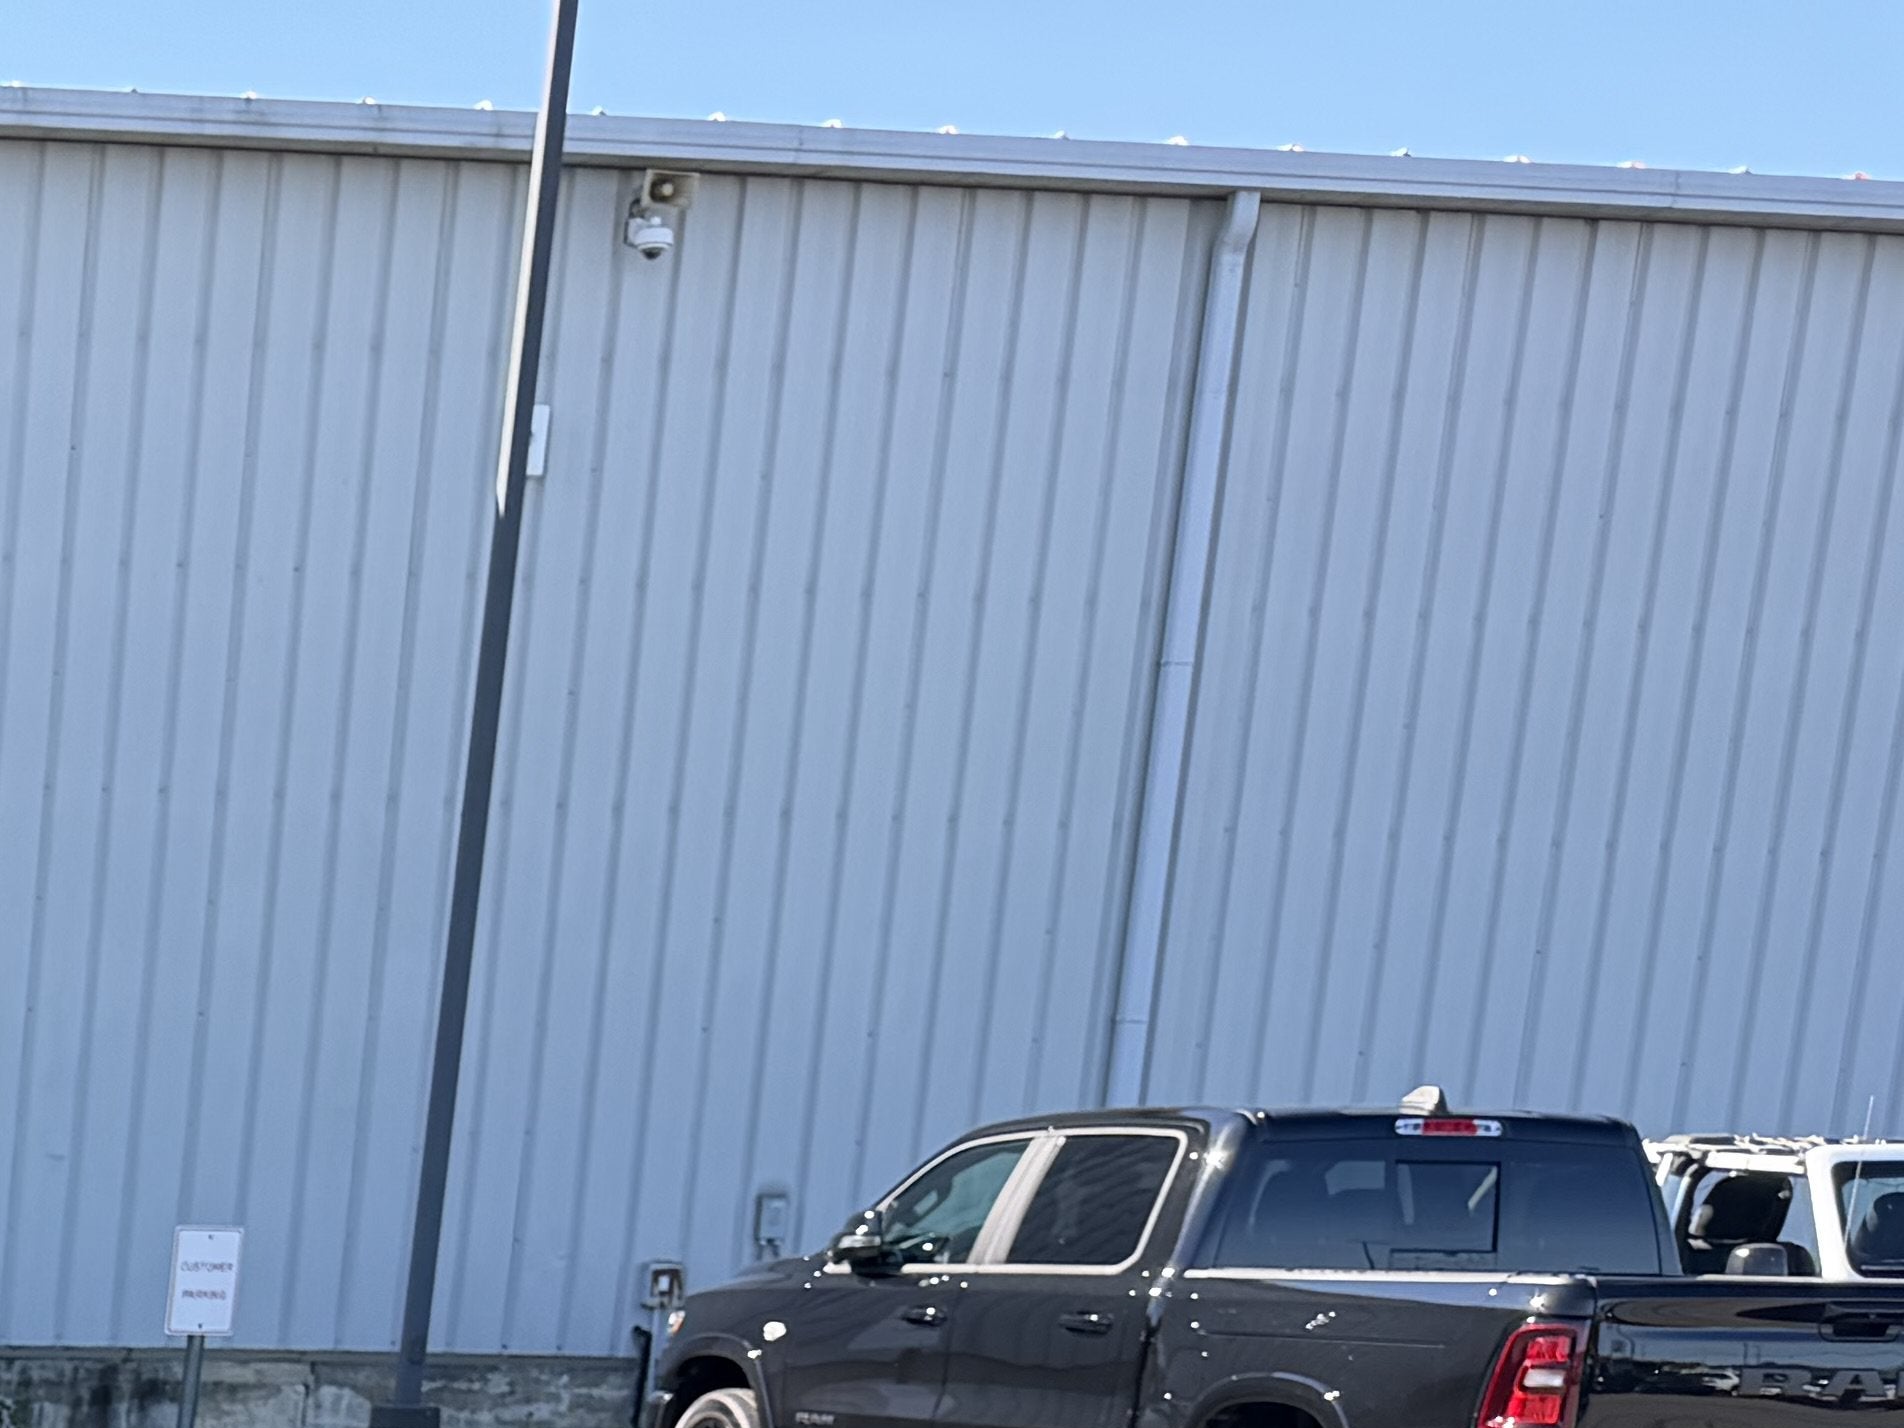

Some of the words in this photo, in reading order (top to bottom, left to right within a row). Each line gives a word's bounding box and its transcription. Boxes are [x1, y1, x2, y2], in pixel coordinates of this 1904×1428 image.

[180, 1261, 233, 1272] CUSTOMER
[181, 1290, 226, 1300] PARKING
[1740, 1368, 1904, 1398] RA
